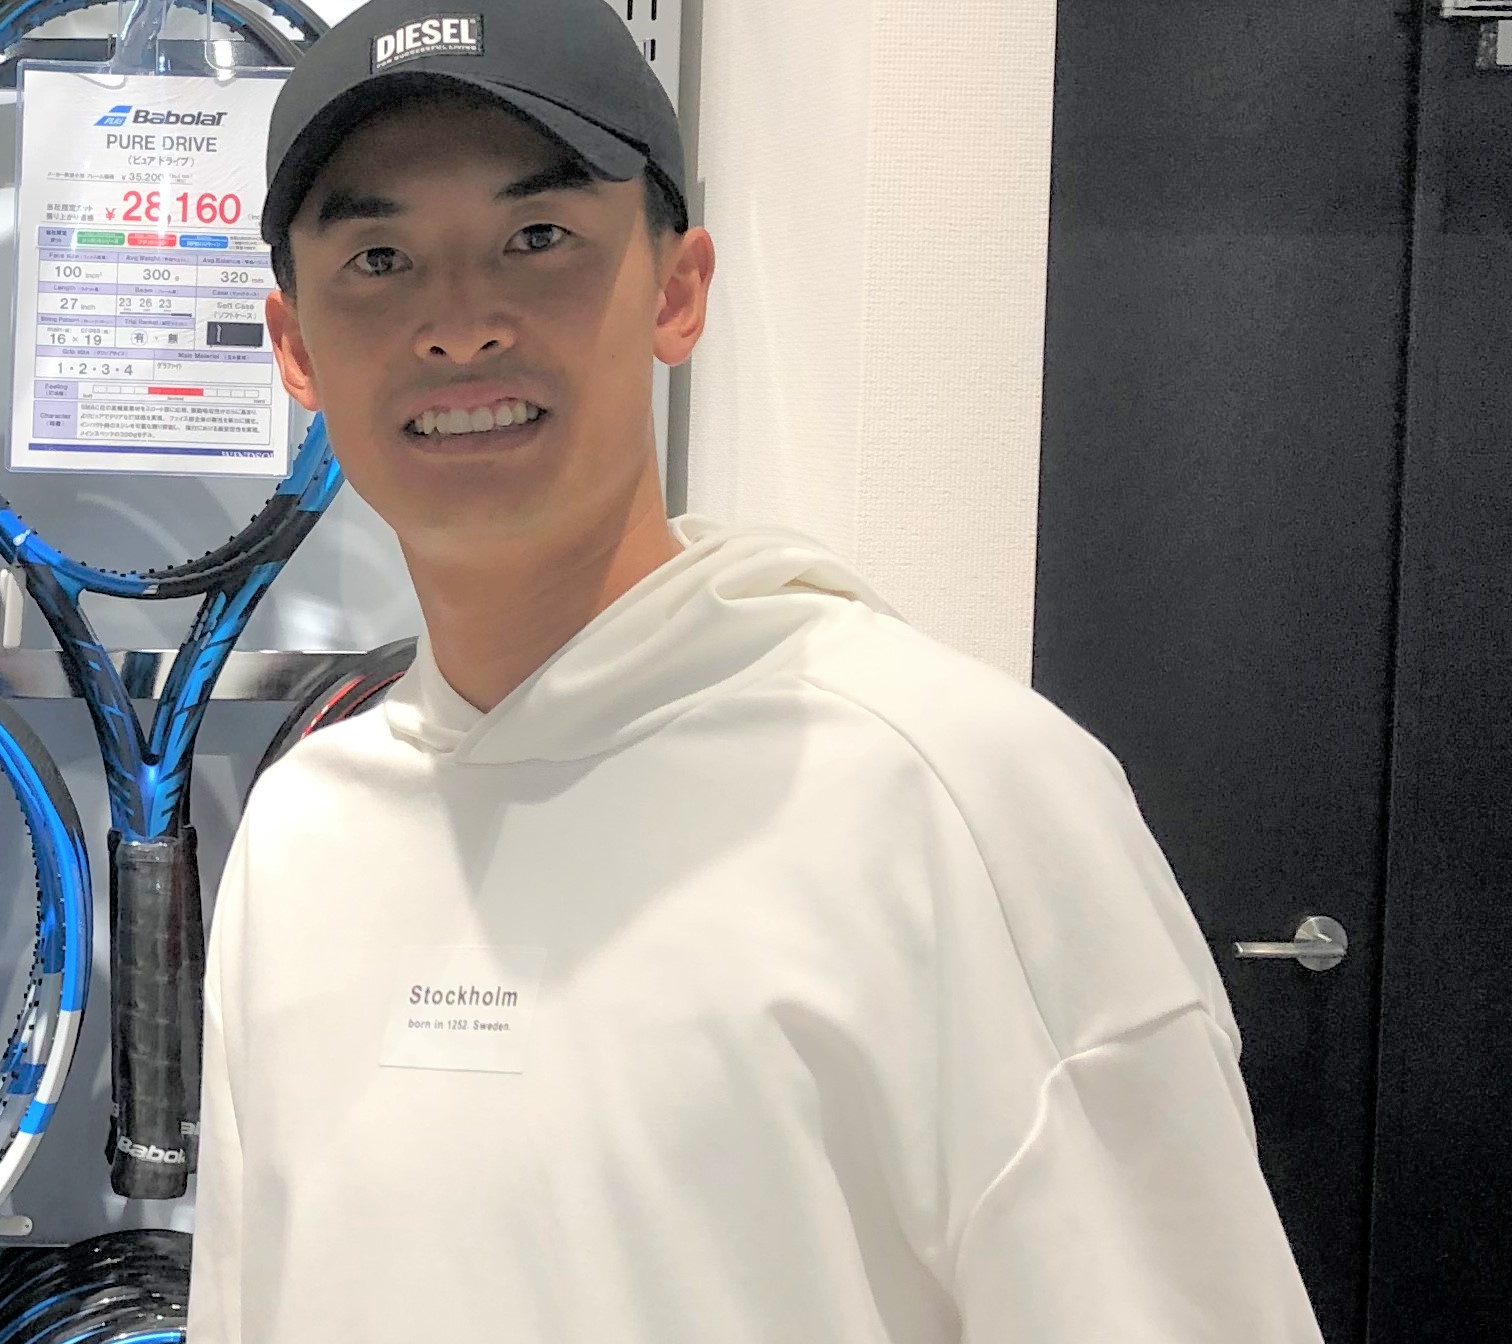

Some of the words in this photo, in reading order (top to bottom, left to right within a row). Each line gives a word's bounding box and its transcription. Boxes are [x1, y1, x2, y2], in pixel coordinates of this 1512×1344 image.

[376, 19, 476, 63] DIESEL
[106, 134, 155, 150] PURE
[163, 136, 217, 152] DRIVE
[105, 208, 116, 221] ¥
[122, 190, 241, 225] 28,160
[55, 266, 82, 278] 100
[143, 269, 170, 280] 300
[220, 271, 248, 283] 320
[60, 298, 78, 310] 27
[119, 298, 131, 307] 23
[139, 299, 152, 308] 26
[159, 299, 172, 309] 23
[50, 333, 66, 344] 16
[85, 335, 102, 346] 19
[409, 985, 518, 1007] Stockholm
[408, 1019, 431, 1029] born
[434, 1019, 443, 1029] in
[473, 1020, 511, 1031] Sweden.
